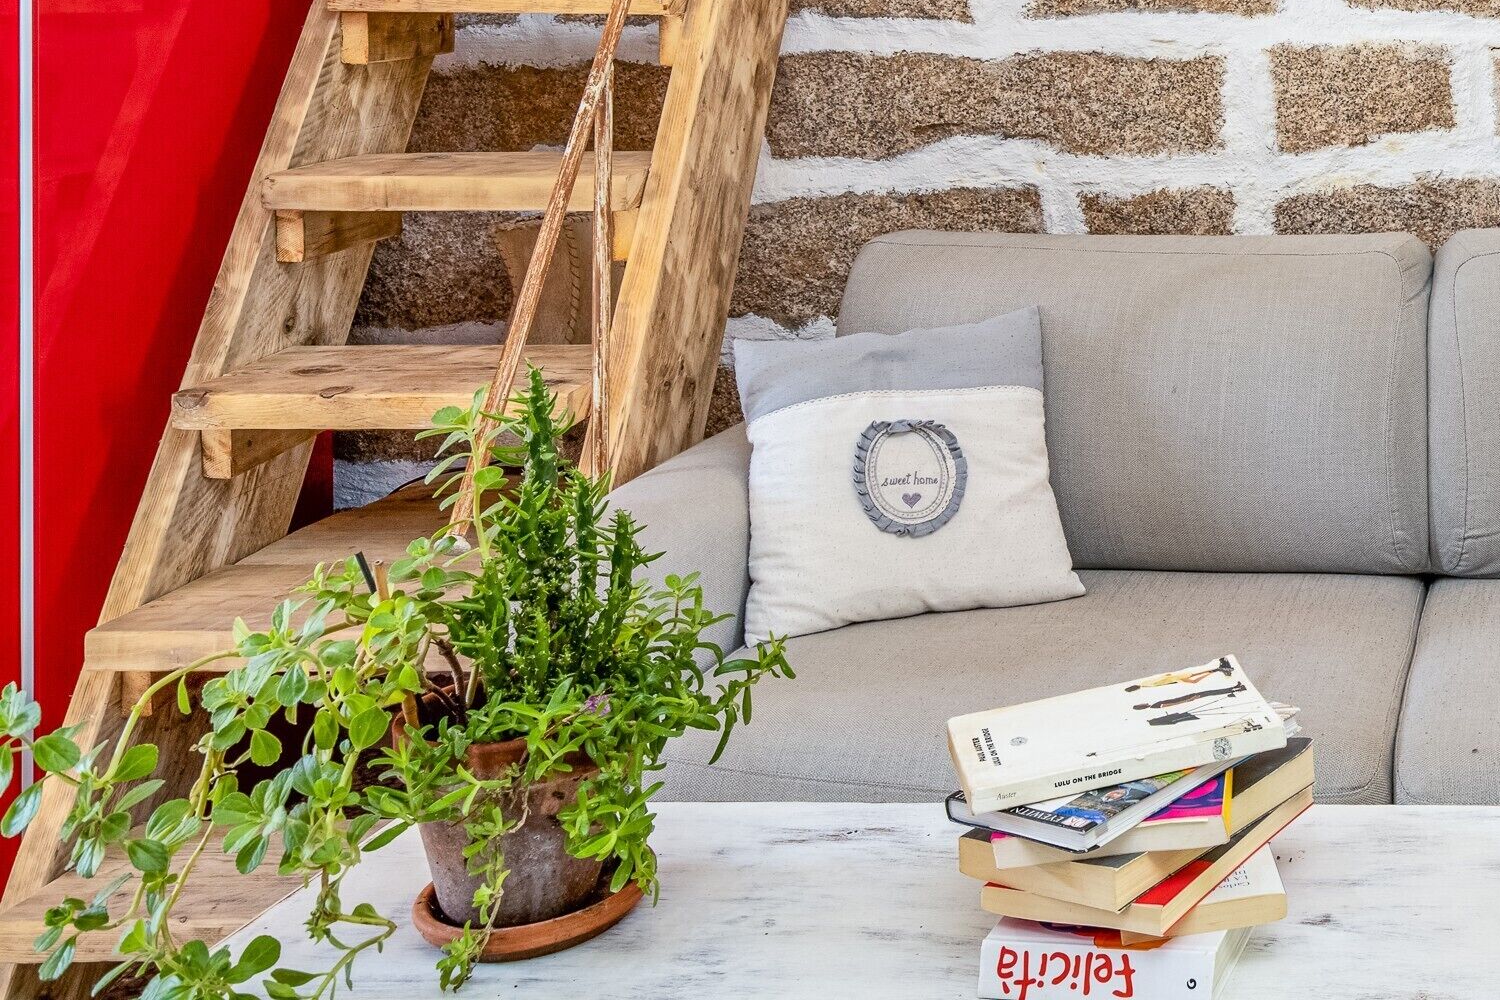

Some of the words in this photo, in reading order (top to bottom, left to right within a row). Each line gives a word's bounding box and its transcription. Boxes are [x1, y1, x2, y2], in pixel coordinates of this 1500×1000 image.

[881, 473, 912, 487] sweet
[913, 471, 939, 485] home
[1054, 778, 1071, 788] LULU
[1072, 776, 1083, 784] ON
[1084, 773, 1097, 782] THE
[1098, 768, 1122, 779] BRIDGE
[996, 791, 1018, 801] Auster
[1010, 806, 1063, 823] EYEWITN
